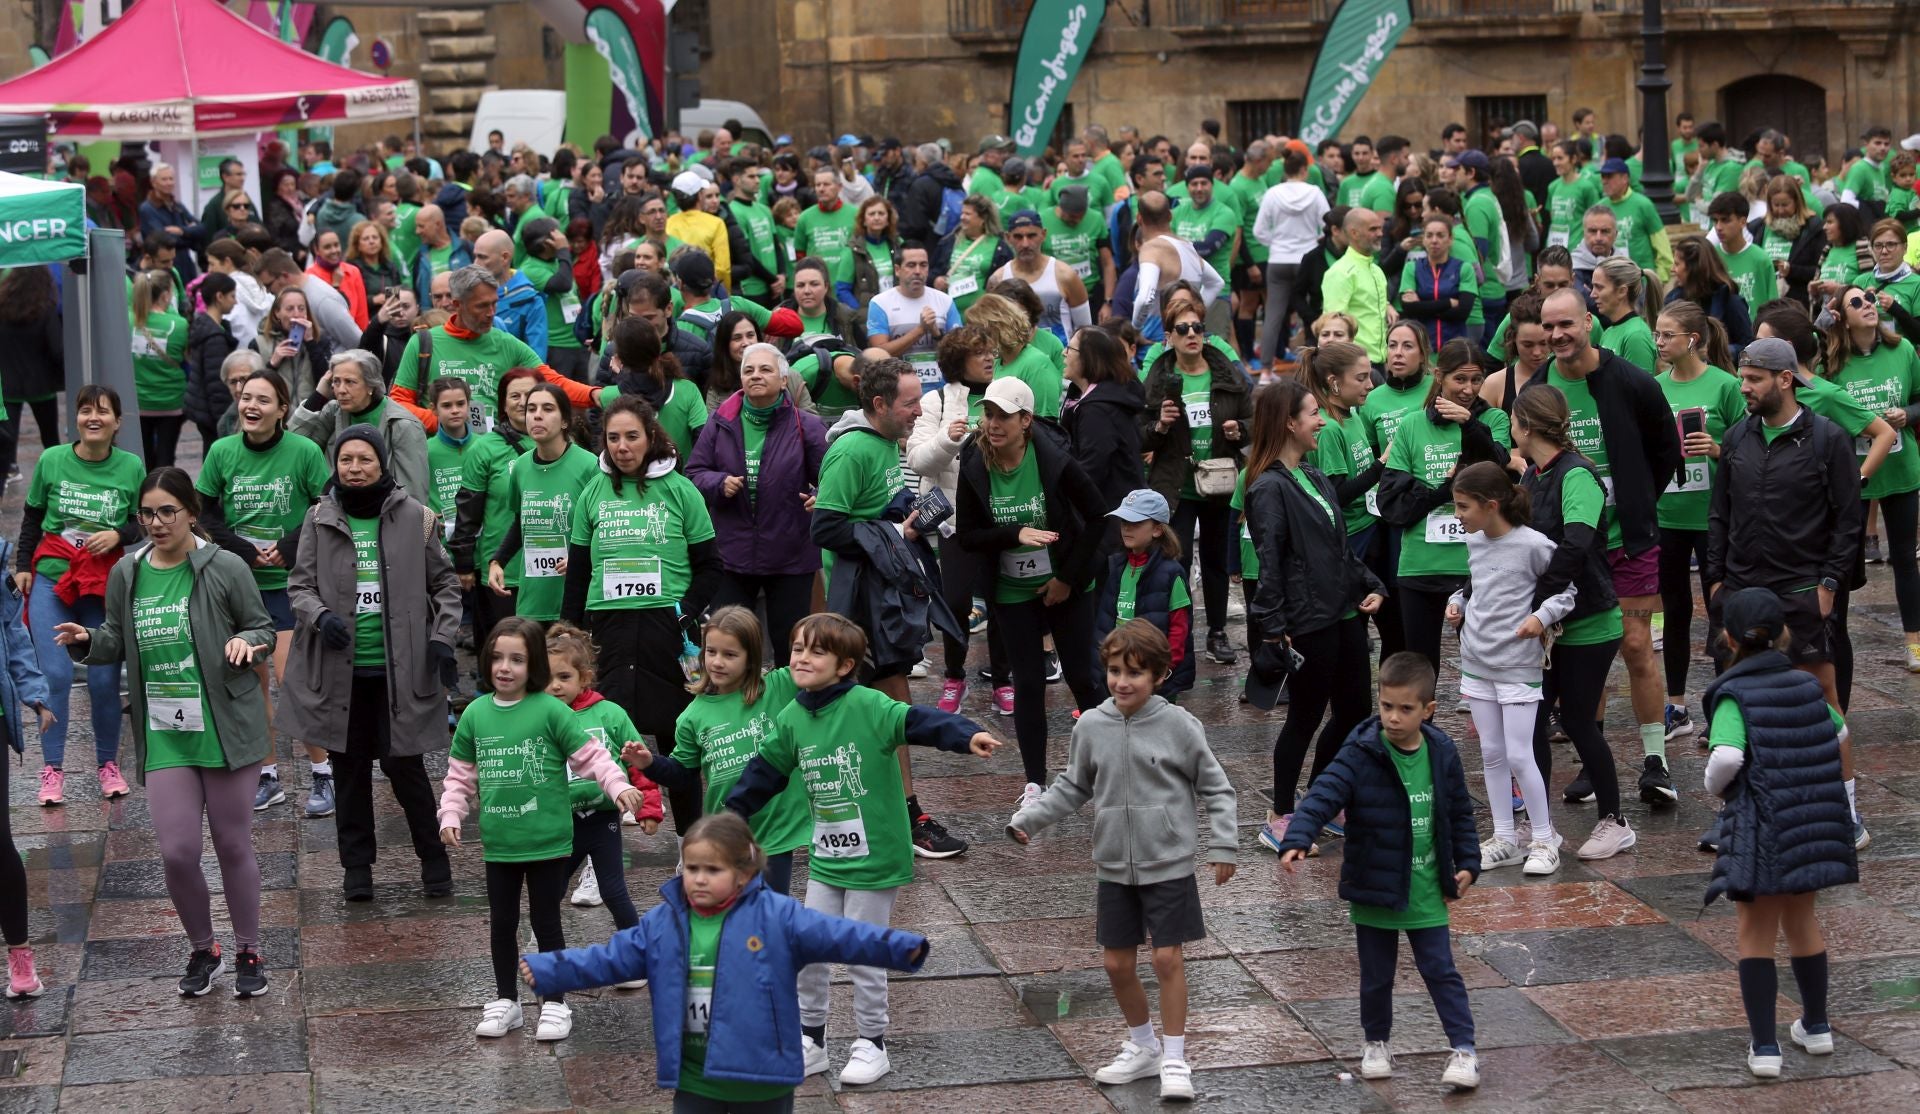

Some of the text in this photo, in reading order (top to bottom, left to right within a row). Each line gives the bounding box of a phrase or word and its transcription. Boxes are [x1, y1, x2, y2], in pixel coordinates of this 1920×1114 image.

[109, 106, 182, 124] LABORAL
[470, 406, 481, 428] 925
[1424, 452, 1438, 461] En
[1425, 461, 1456, 470] contra
[232, 481, 281, 493] En marcha
[60, 488, 110, 502] En marcha
[233, 493, 262, 501] contra
[59, 497, 88, 508] contra
[234, 499, 275, 511] el cáncer
[59, 505, 102, 519] el cáncer
[599, 507, 652, 520] En marcha
[526, 515, 555, 526] cáncer
[599, 519, 630, 530] contra
[599, 526, 648, 539] el cáncer
[1016, 559, 1036, 571] 74
[615, 582, 656, 596] 1796
[145, 601, 185, 614] marcha
[142, 625, 180, 639] cáncer
[174, 708, 185, 722] 4
[714, 726, 758, 748] marcha
[487, 745, 530, 757] marcha
[705, 746, 735, 764] contra
[478, 758, 504, 769] contra
[716, 751, 759, 771] cáncer
[807, 754, 845, 768] marcha
[485, 767, 522, 779] cáncer
[484, 805, 520, 814] LABORAL
[820, 832, 860, 848] 1829
